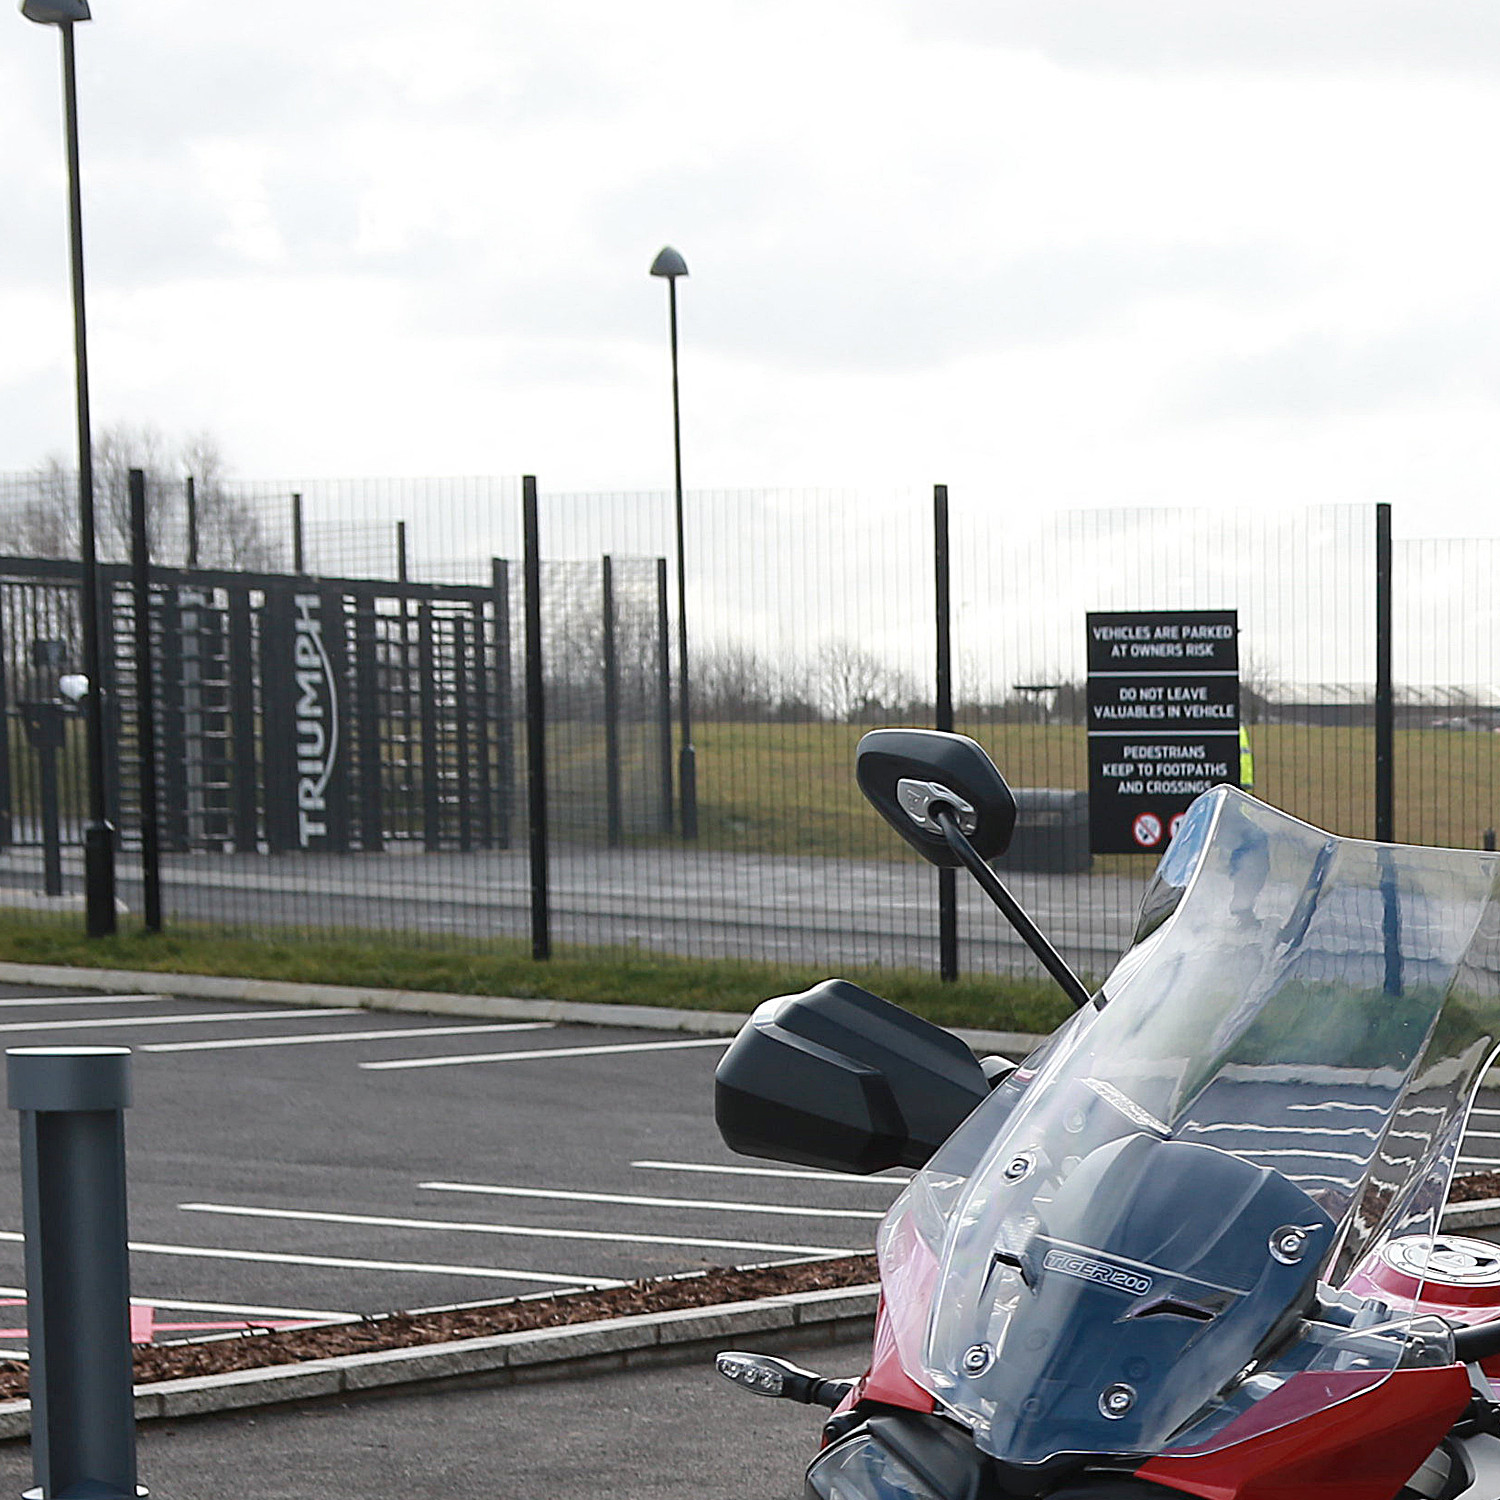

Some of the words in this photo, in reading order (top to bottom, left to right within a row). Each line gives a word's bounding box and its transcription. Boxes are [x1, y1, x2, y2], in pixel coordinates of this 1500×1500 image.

[1093, 626, 1151, 640] VEHICLES
[1154, 625, 1179, 640] ARE
[1182, 624, 1233, 639] PARKED
[1111, 644, 1128, 657] AT
[1130, 643, 1183, 657] OWNERS
[1186, 643, 1214, 657] RISK
[1120, 687, 1137, 701] DO
[1140, 687, 1164, 701] NOT
[1167, 687, 1208, 700] LEAVE
[1093, 705, 1165, 719] VALUABLES
[1168, 705, 1180, 718] IN
[1183, 704, 1235, 718] VEHICLE
[294, 594, 338, 847] TRIUMPH
[1123, 745, 1205, 759] PEDESTRIANS
[1102, 763, 1134, 777] KEEP
[1137, 763, 1153, 776] TO
[1156, 763, 1228, 776] FOOTPATHS
[1118, 781, 1144, 794] AND
[1047, 1253, 1113, 1282] TIGER
